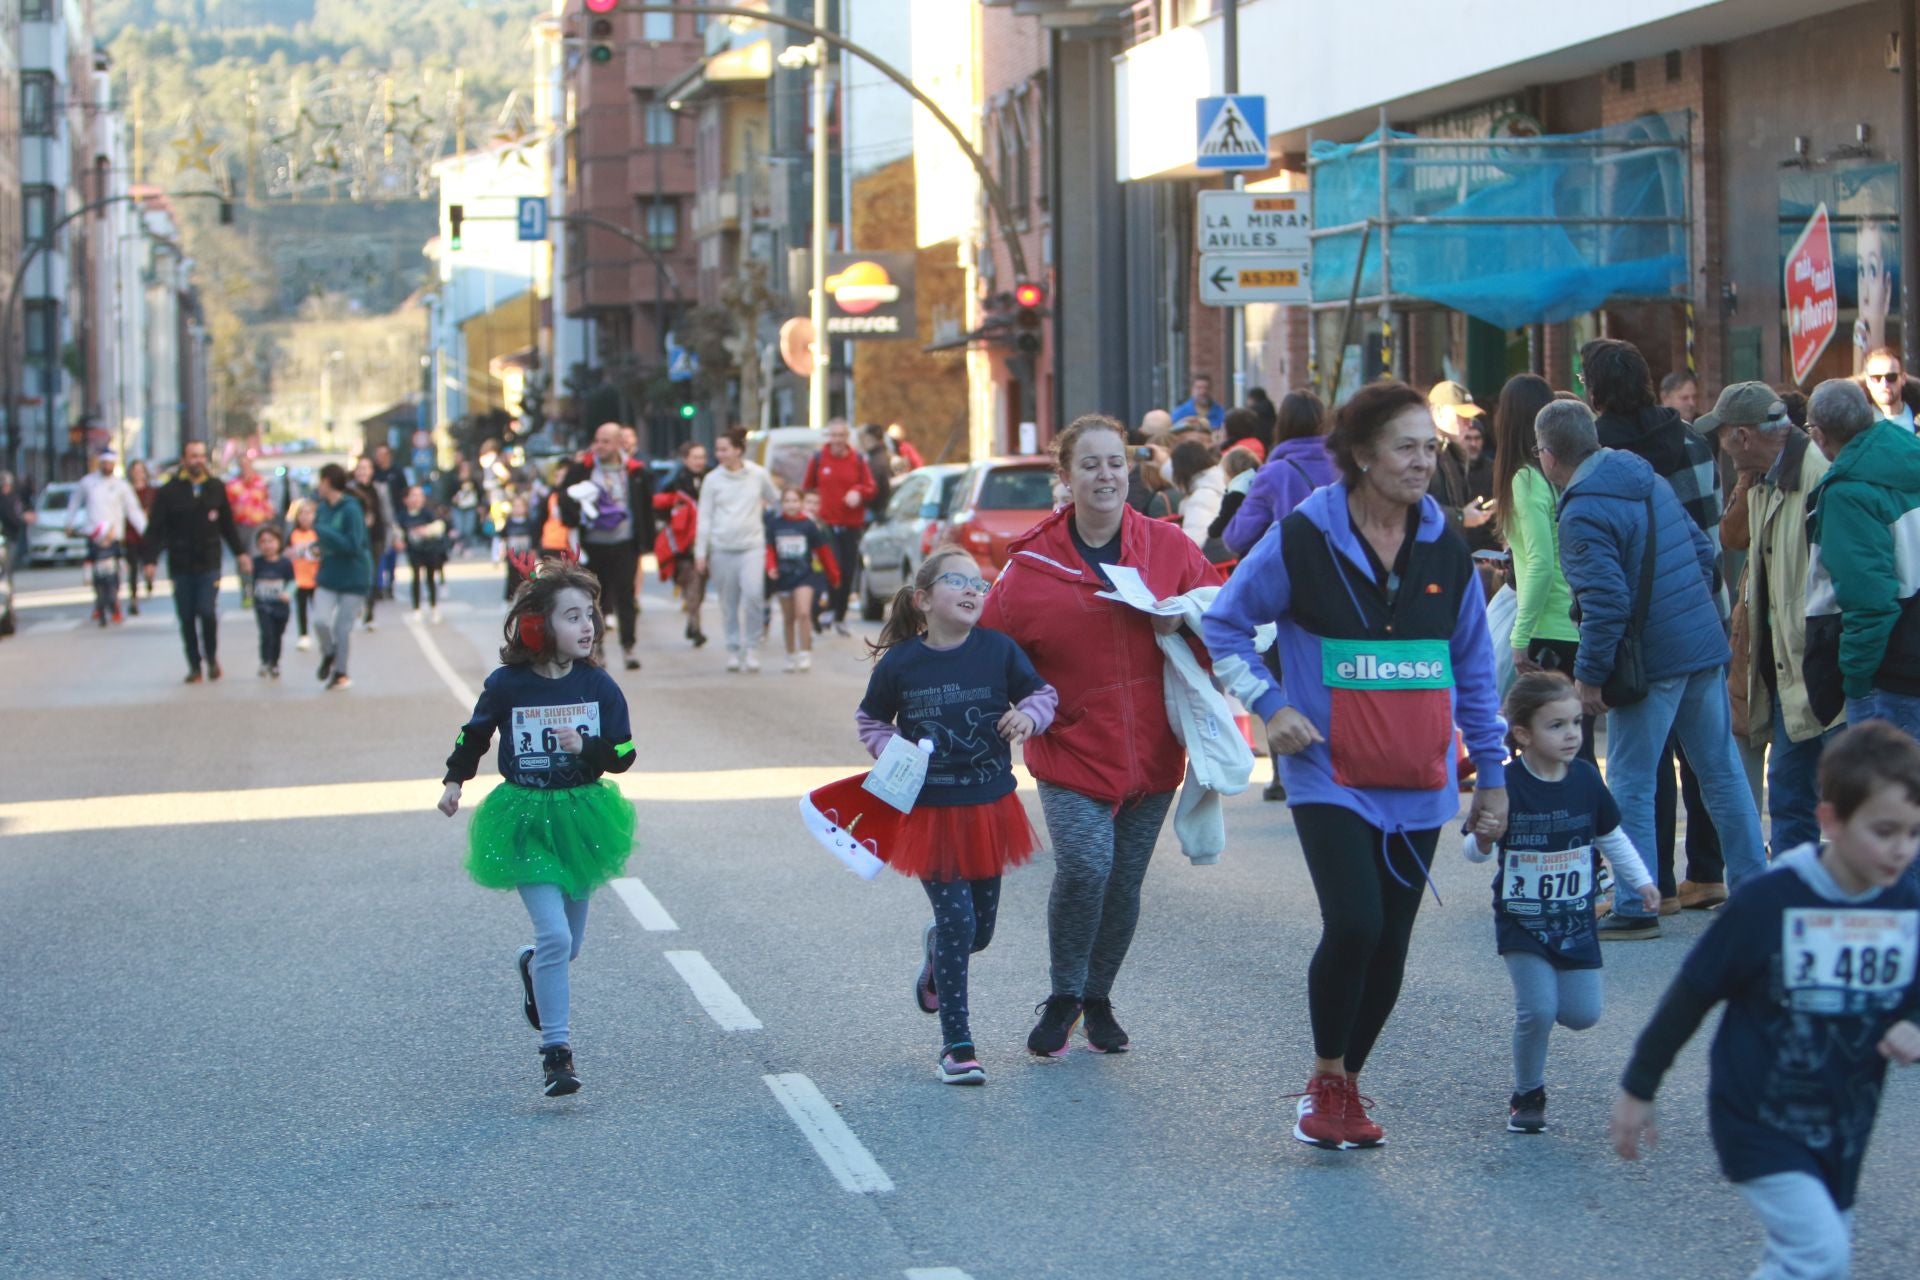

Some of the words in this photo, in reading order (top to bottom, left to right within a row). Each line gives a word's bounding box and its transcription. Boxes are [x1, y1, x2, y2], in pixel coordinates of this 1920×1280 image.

[1206, 214, 1231, 228] LA
[1208, 232, 1277, 247] AVILES
[827, 316, 900, 333] REPSOL
[1337, 654, 1443, 679] ellesse
[942, 682, 960, 693] 2024
[525, 709, 541, 719] SAN
[544, 705, 587, 718] SILVESTRE
[540, 717, 573, 725] LLANERA
[1519, 853, 1538, 864] SAN
[1538, 870, 1581, 900] 670
[1834, 946, 1903, 985] 486
